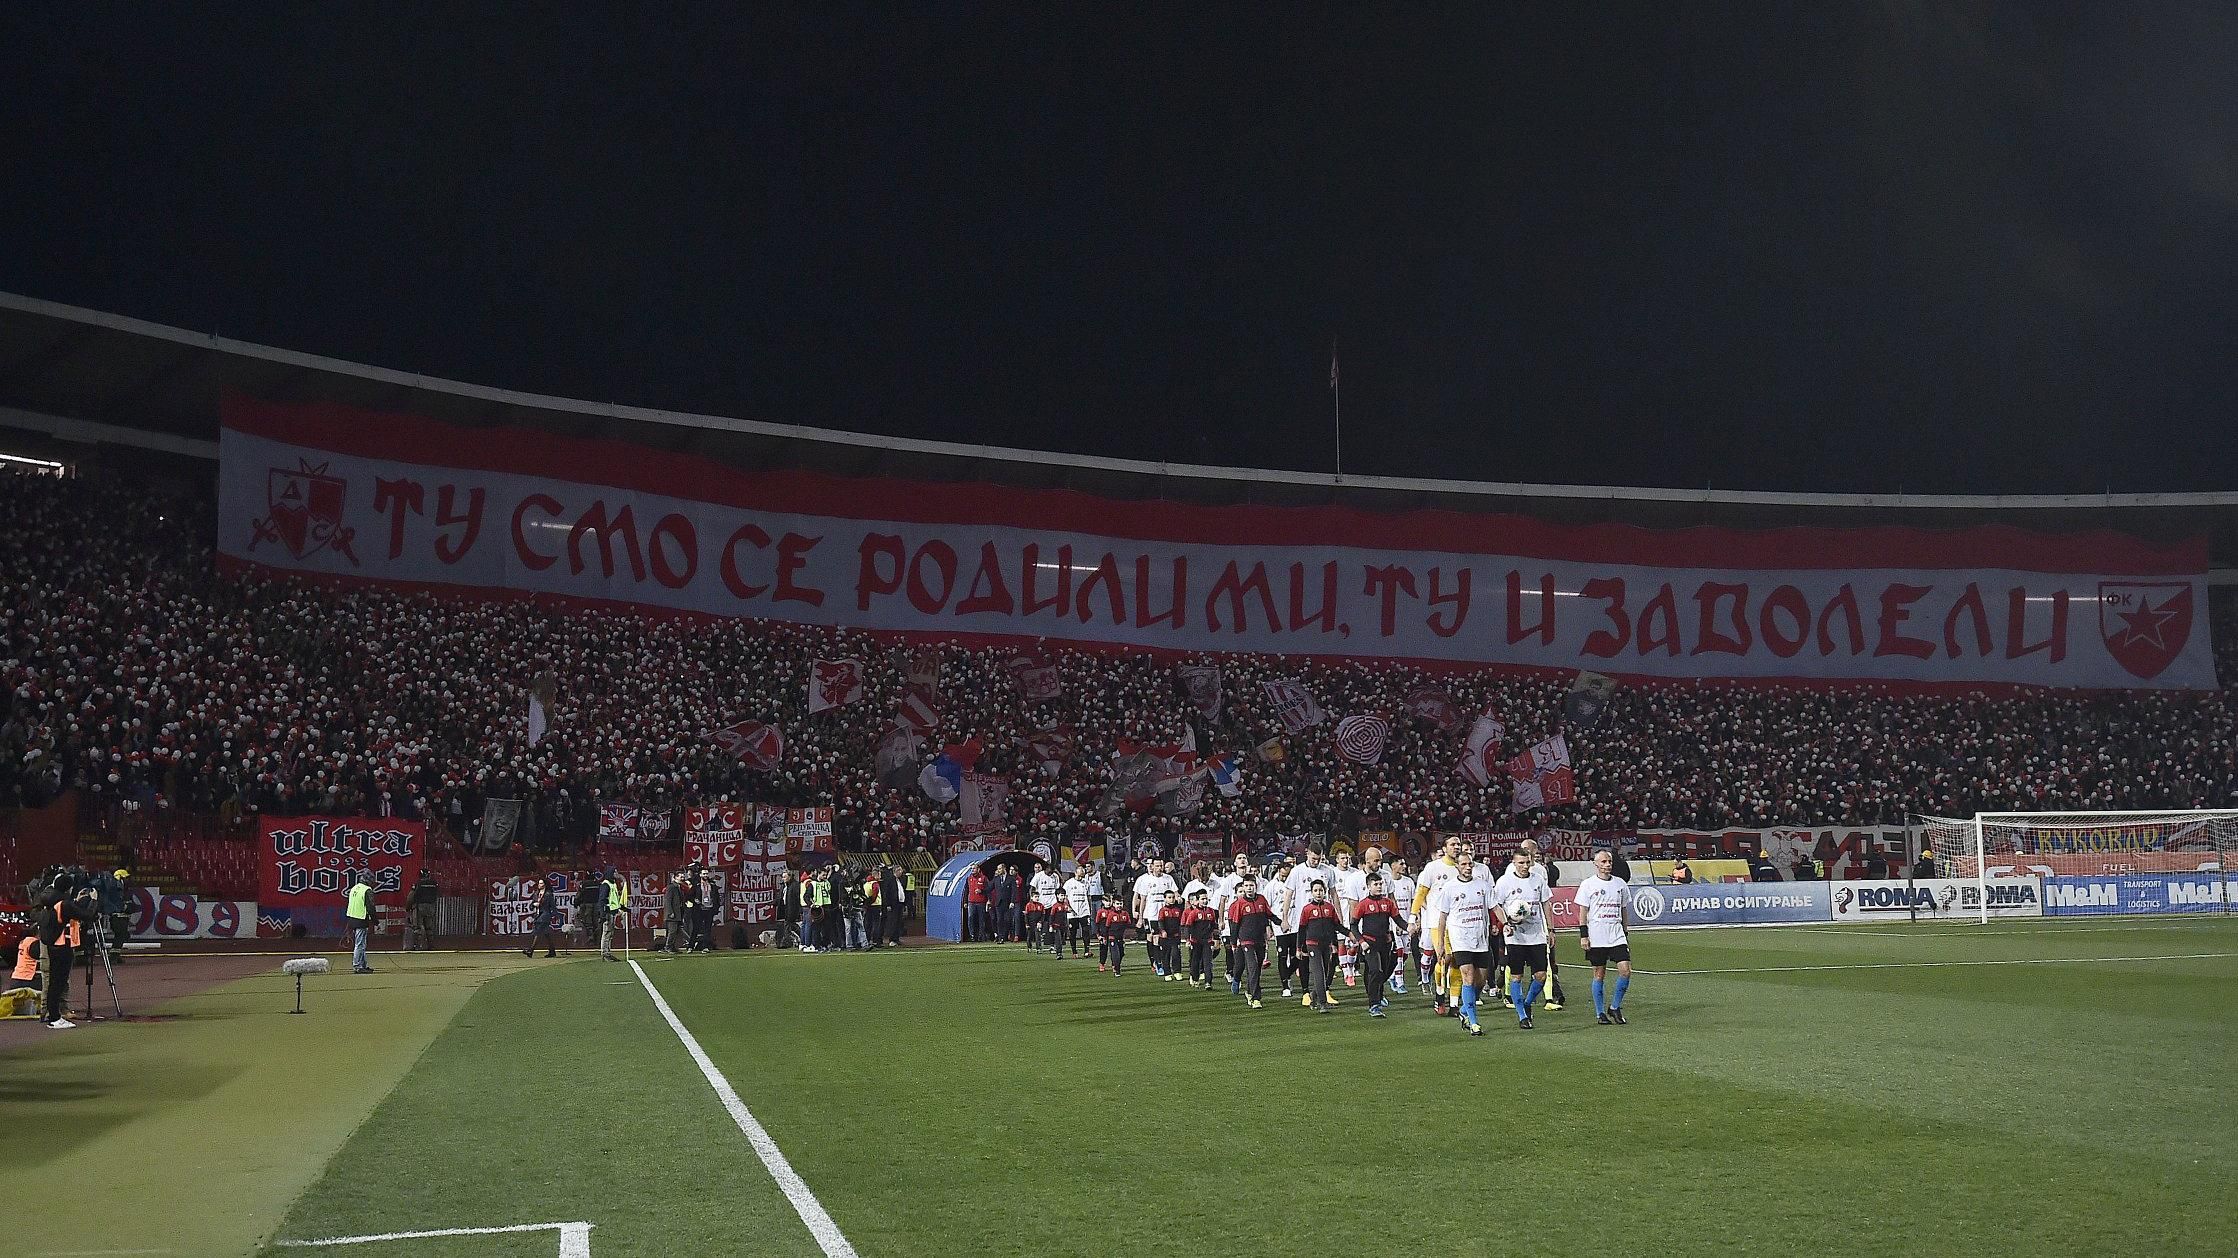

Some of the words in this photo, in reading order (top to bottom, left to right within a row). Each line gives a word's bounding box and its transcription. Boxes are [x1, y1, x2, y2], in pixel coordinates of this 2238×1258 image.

[373, 476, 485, 564] ТУ
[511, 493, 698, 589] СМО
[719, 523, 825, 608] СЕ
[856, 531, 1189, 632] РОДИЛИ
[1205, 557, 1350, 639] МИ,
[1363, 563, 1472, 638] ТУ
[1505, 569, 1555, 648] И
[1579, 577, 2068, 665] ЗАВОЛЕЛИ
[269, 820, 413, 857] ultra
[687, 830, 742, 844] ГРАЧАНИЦА
[317, 856, 369, 867] 1993
[2103, 863, 2135, 871] FUEL
[2124, 880, 2161, 888] TRANSPORT
[1671, 897, 1720, 913] ДУНАВ
[1724, 894, 1813, 909] ОСИГУРАЊЕ
[1858, 887, 1936, 907] ROMA
[1962, 884, 2037, 905] ROMA
[2046, 883, 2118, 906] M&M
[2127, 900, 2161, 908] LOGISTICS
